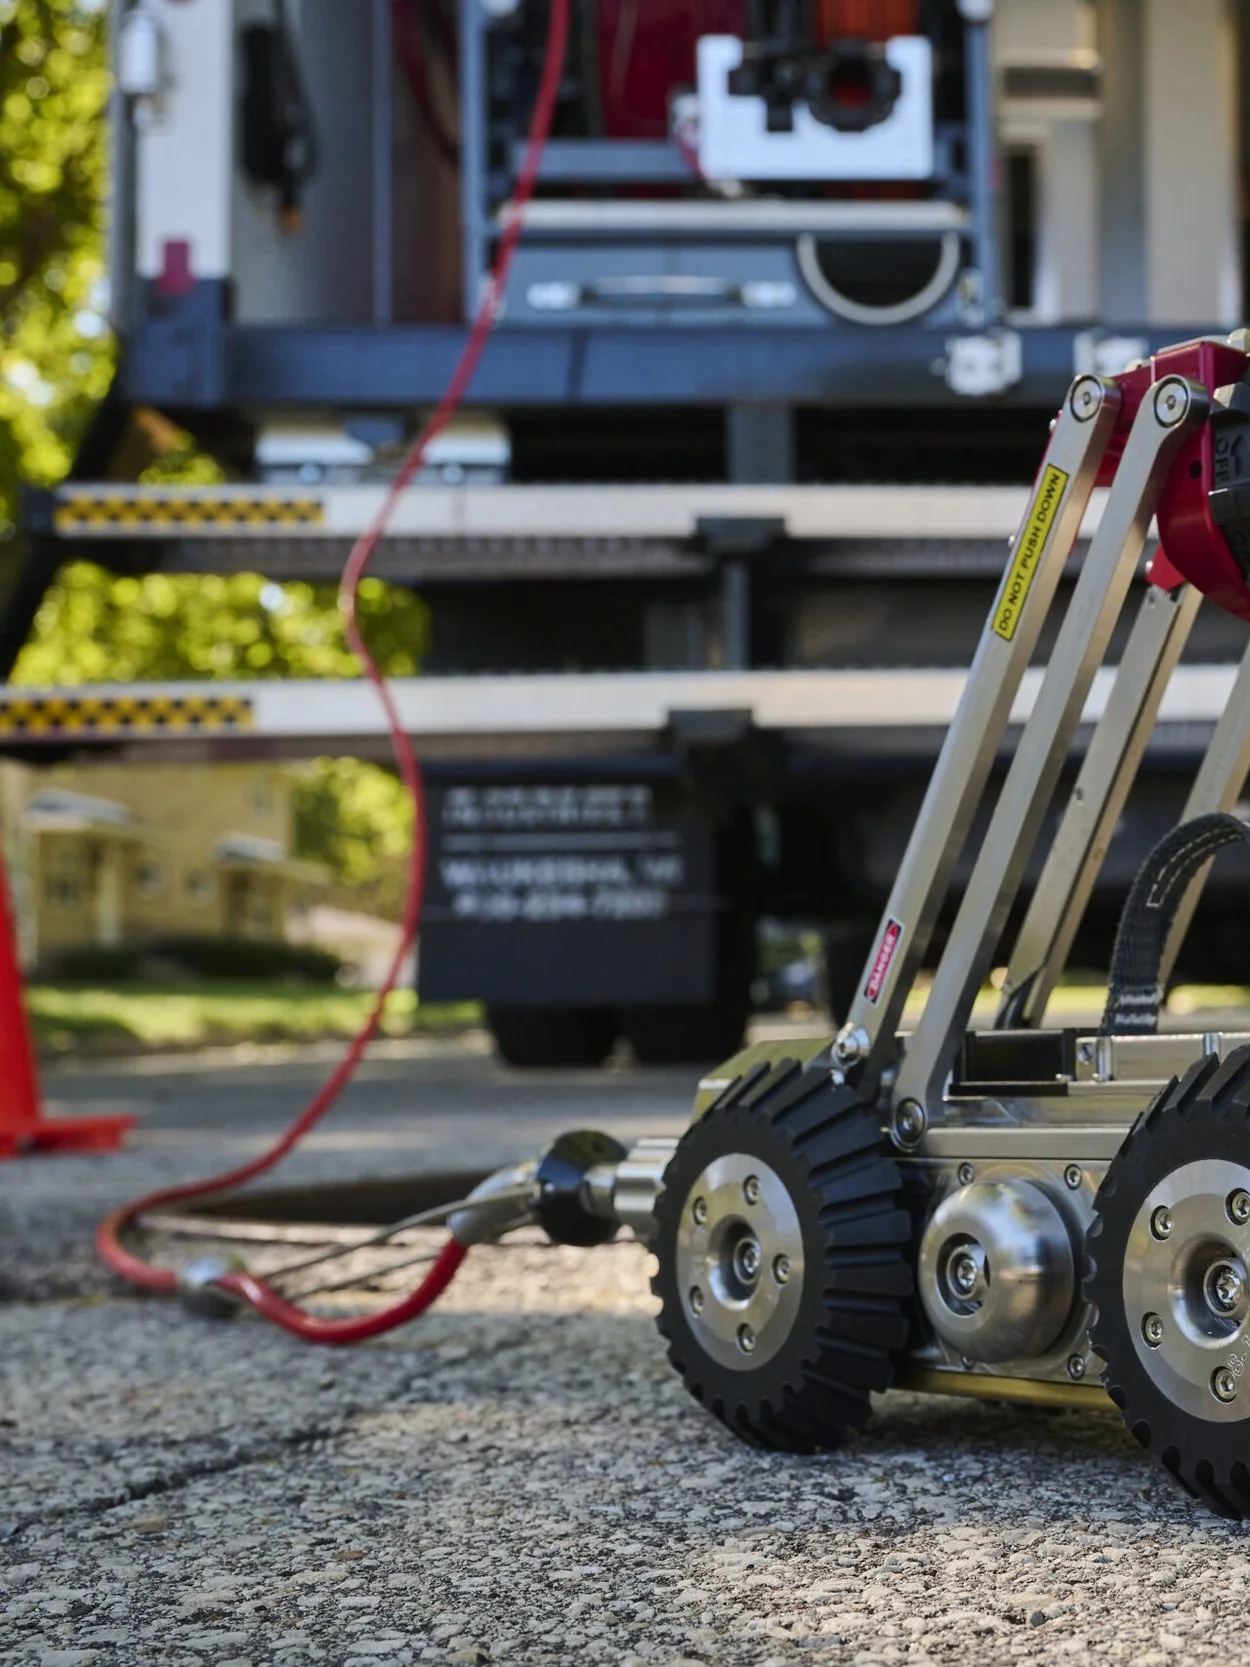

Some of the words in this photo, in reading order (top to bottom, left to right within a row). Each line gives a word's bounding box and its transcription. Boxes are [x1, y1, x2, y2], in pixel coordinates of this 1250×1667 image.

[1214, 435, 1230, 482] OFF
[999, 608, 1014, 632] DO
[1008, 572, 1026, 606] NOT
[1020, 525, 1041, 569] PUSH
[1036, 473, 1060, 523] DOWN
